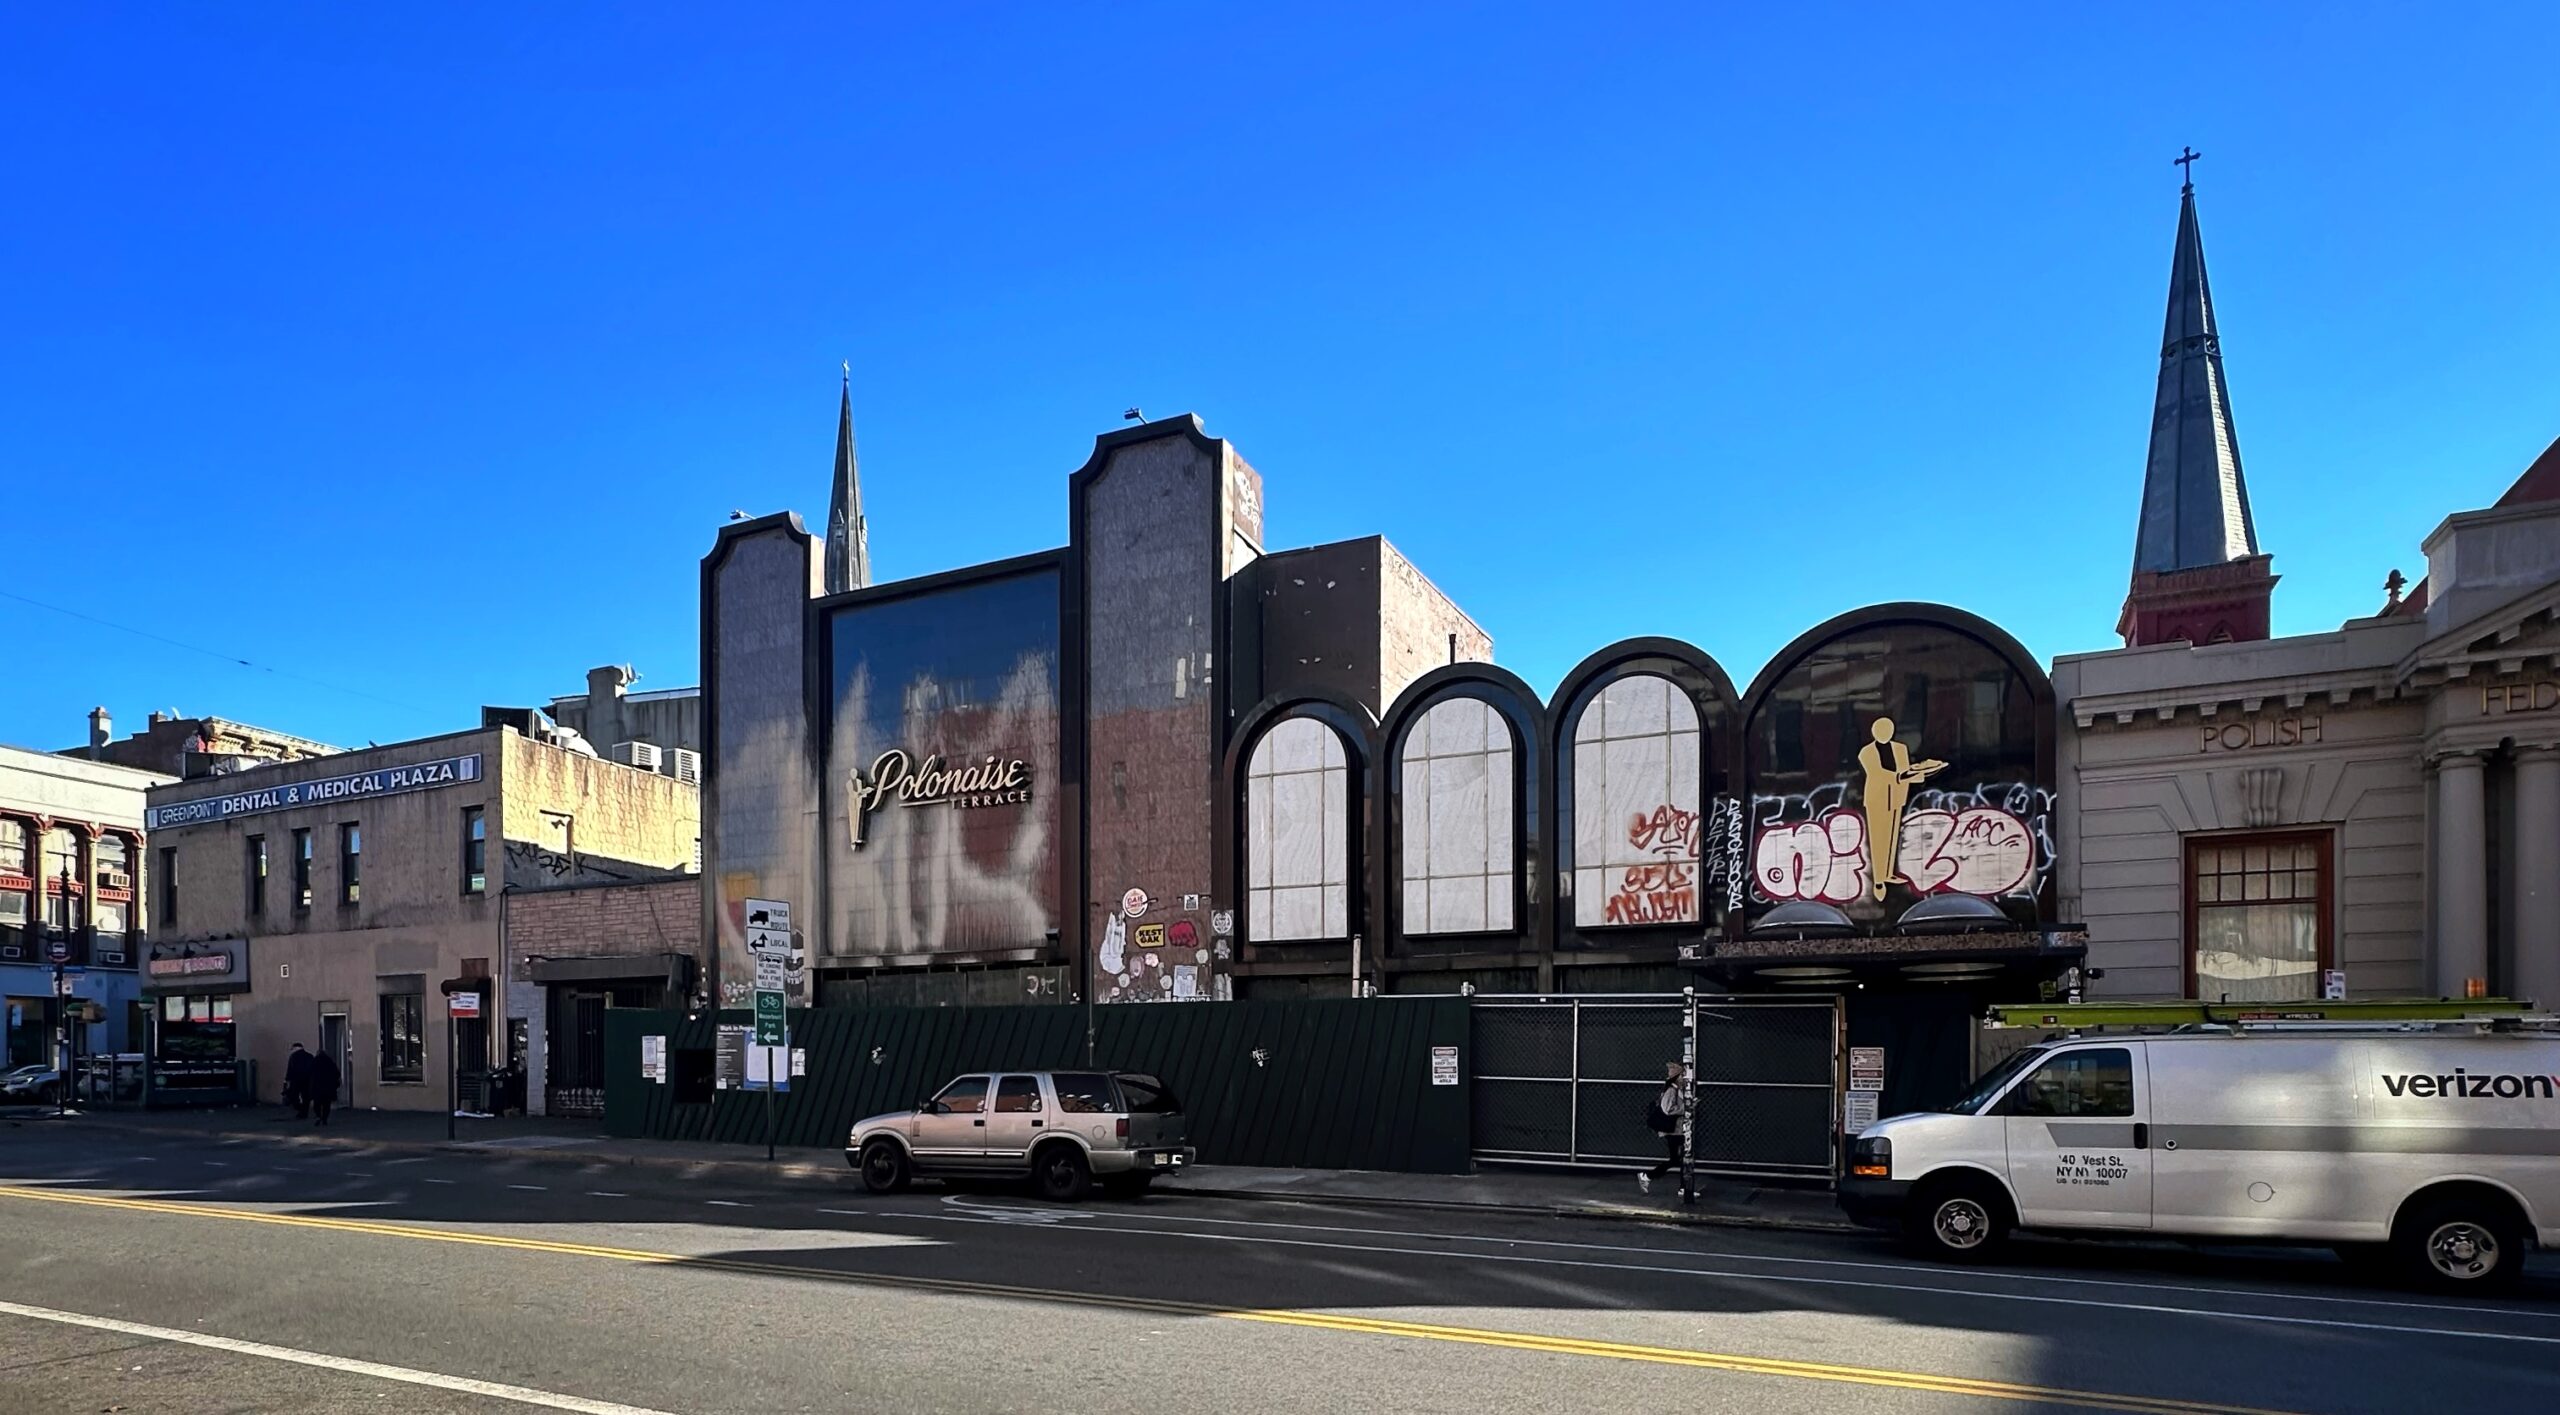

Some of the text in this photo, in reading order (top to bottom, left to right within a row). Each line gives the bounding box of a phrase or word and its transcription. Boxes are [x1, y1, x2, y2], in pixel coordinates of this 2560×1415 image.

[2200, 716, 2323, 752] POLISH
[160, 763, 454, 824] GREENPOINT DENTAL & MEDICAL PLAZA
[866, 749, 1024, 812] Polonaise
[950, 790, 1027, 810] TERRACE
[2381, 1067, 2554, 1099] verizon
[2056, 1166, 2072, 1177] NY
[2095, 1167, 2128, 1179] 10007
